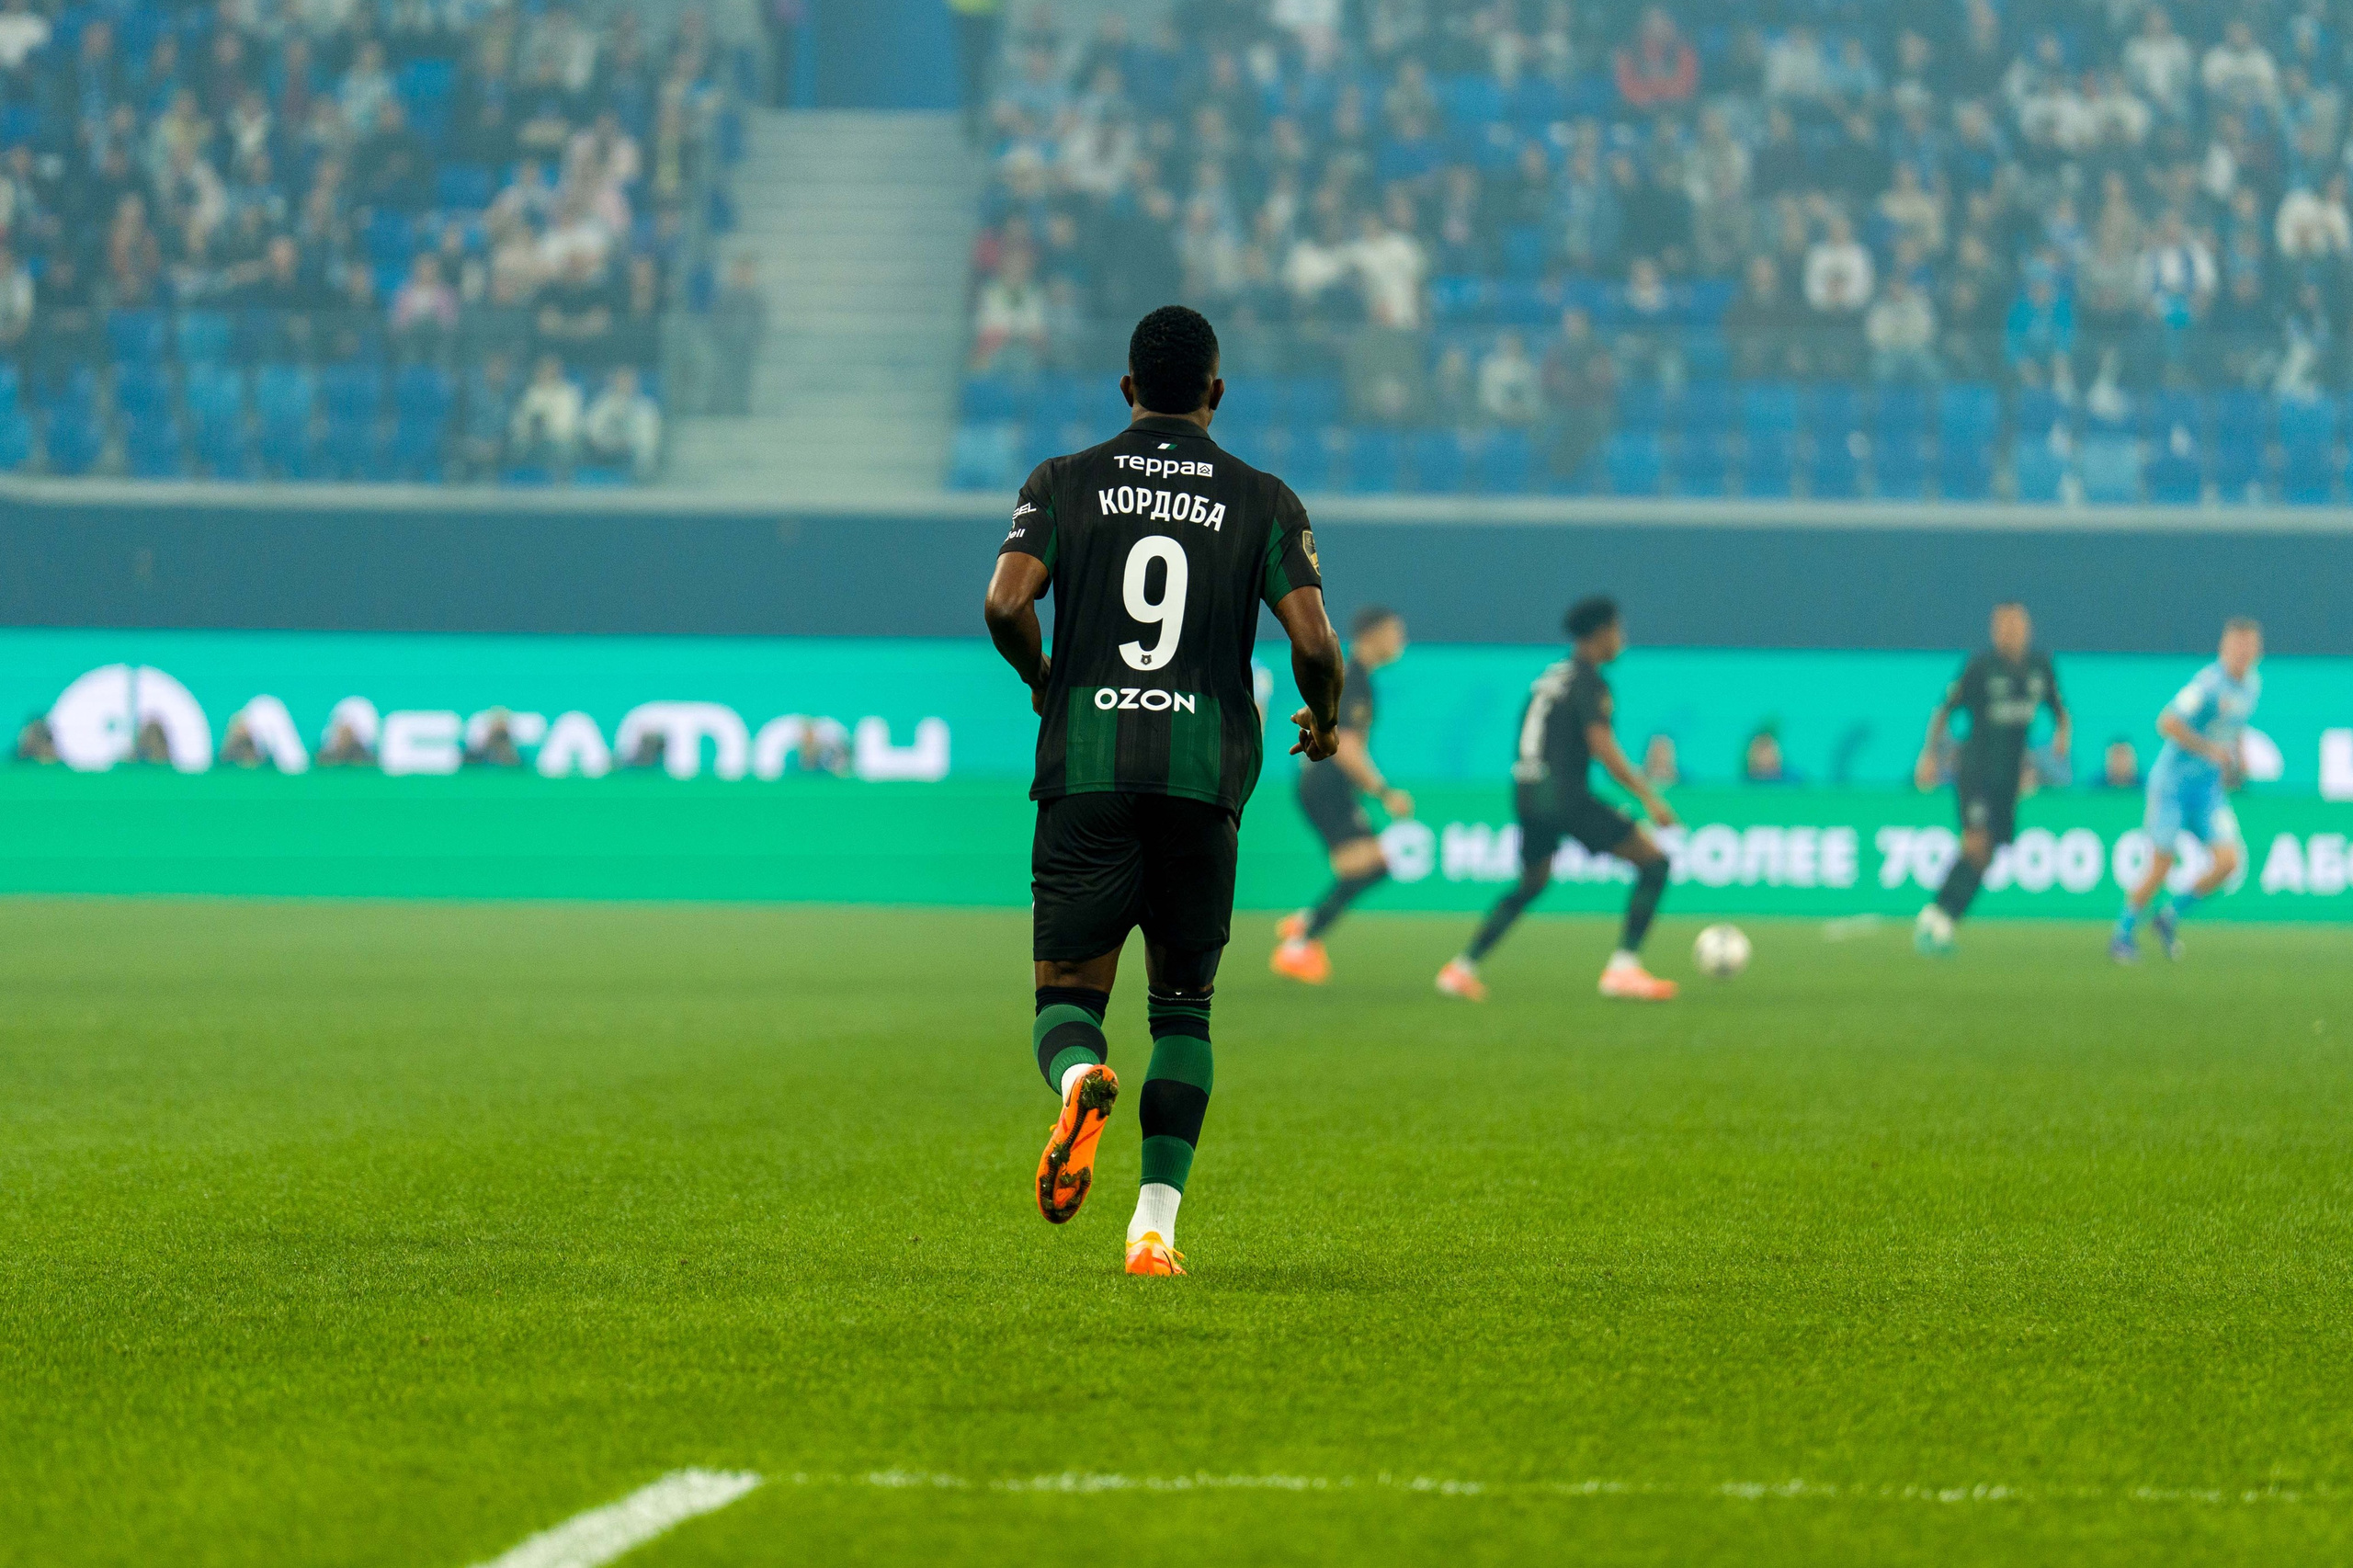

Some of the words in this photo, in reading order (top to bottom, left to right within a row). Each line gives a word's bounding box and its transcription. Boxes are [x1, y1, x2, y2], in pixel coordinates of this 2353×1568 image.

[1113, 454, 1196, 479] терра
[1097, 485, 1226, 532] КОРДОБА
[1119, 535, 1188, 671] 9
[1094, 687, 1195, 714] OZON
